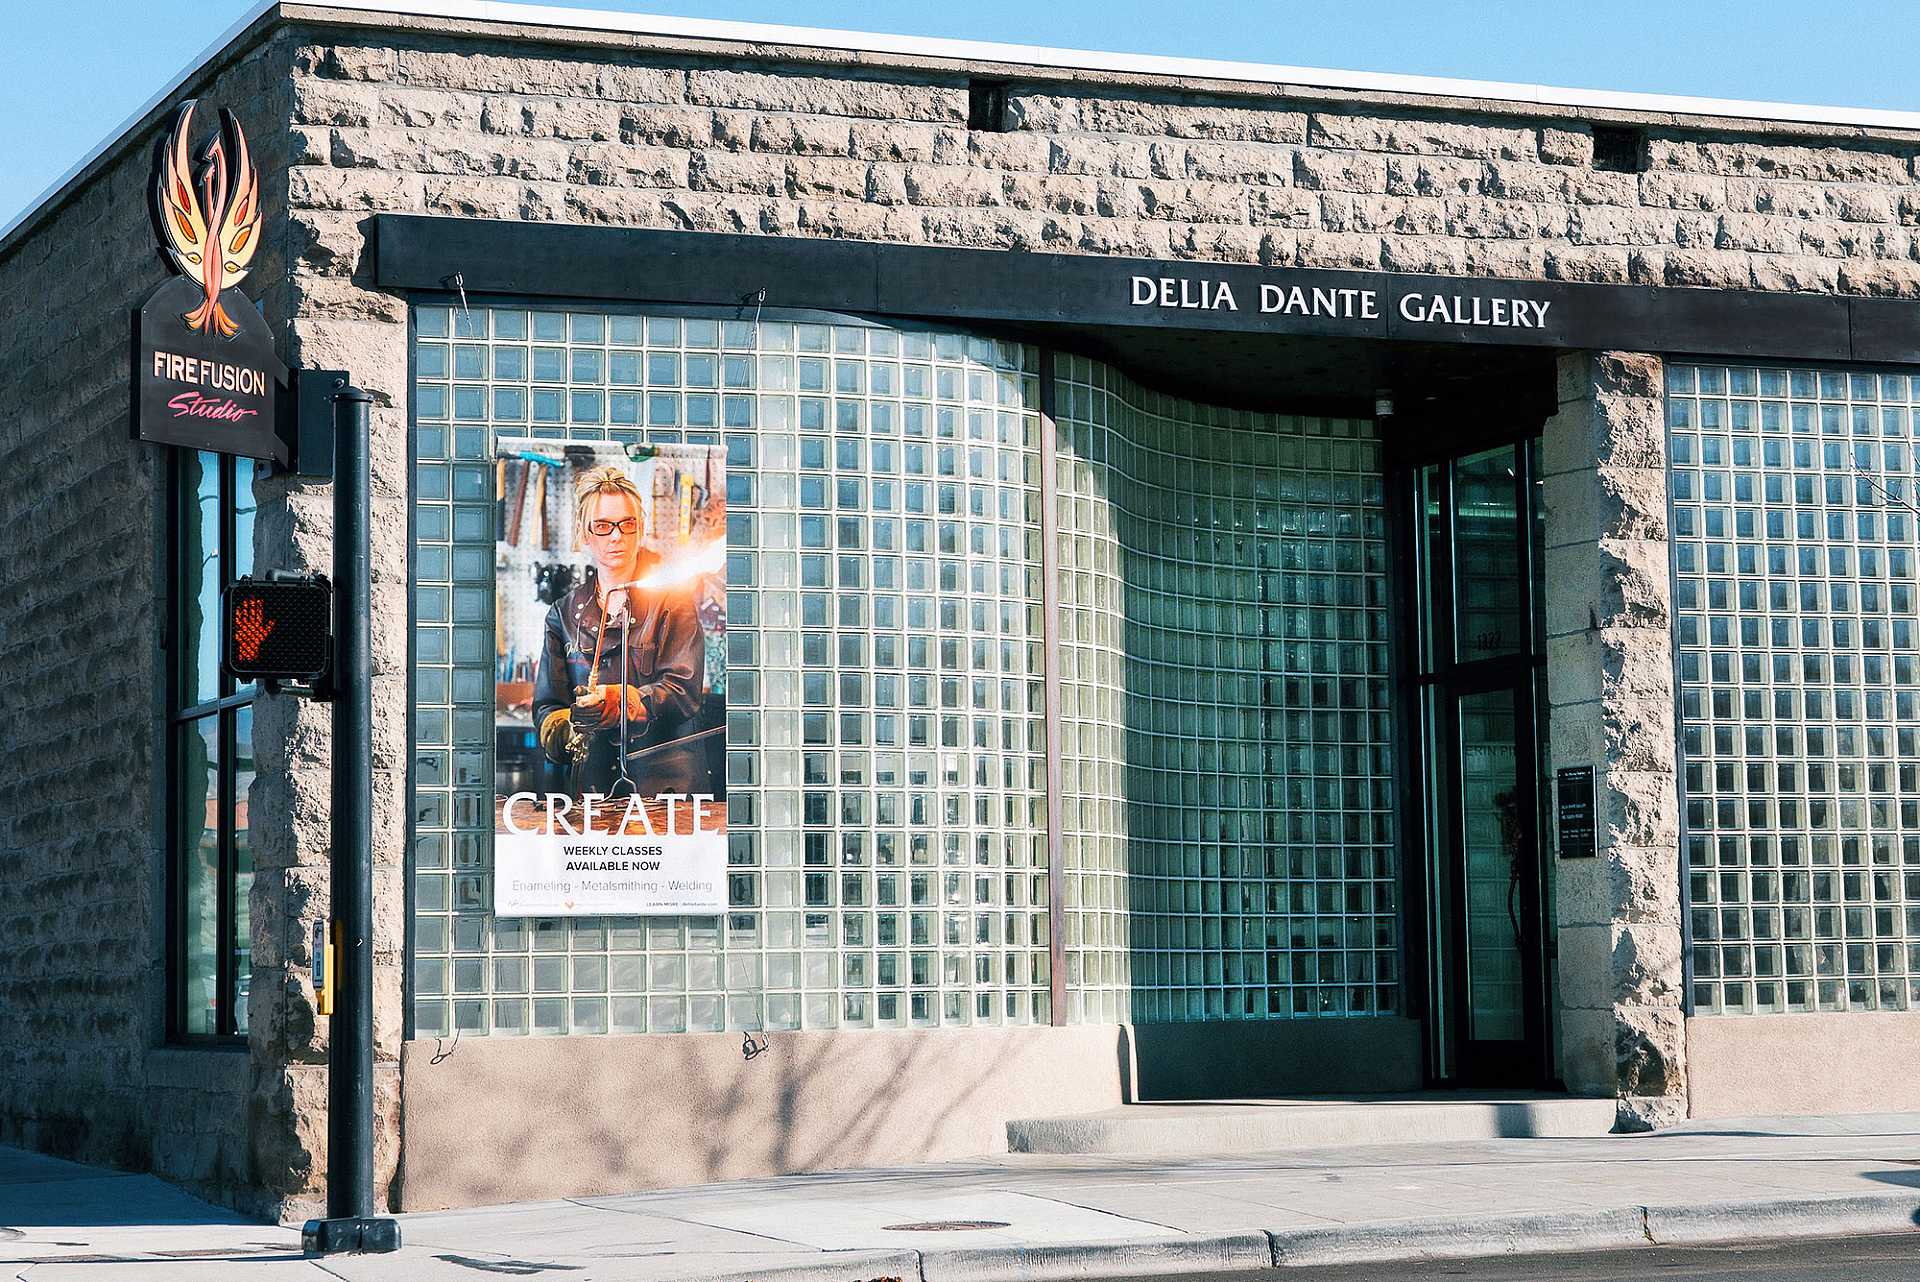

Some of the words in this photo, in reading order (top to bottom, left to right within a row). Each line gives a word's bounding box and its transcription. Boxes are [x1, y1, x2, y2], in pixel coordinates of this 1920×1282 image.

[1131, 276, 1238, 312] DELIA
[1259, 284, 1380, 320] DANTE
[1400, 294, 1551, 329] GALLERY
[167, 391, 259, 422] Studio
[502, 791, 719, 837] CREATE
[563, 846, 609, 856] WEEKLY
[611, 846, 663, 856] CLASSES
[565, 861, 629, 871] AVAILABLE
[632, 861, 661, 871] NOW
[512, 880, 571, 894] Enameling
[581, 880, 658, 894] Metalsmithing
[668, 880, 713, 893] Welding
